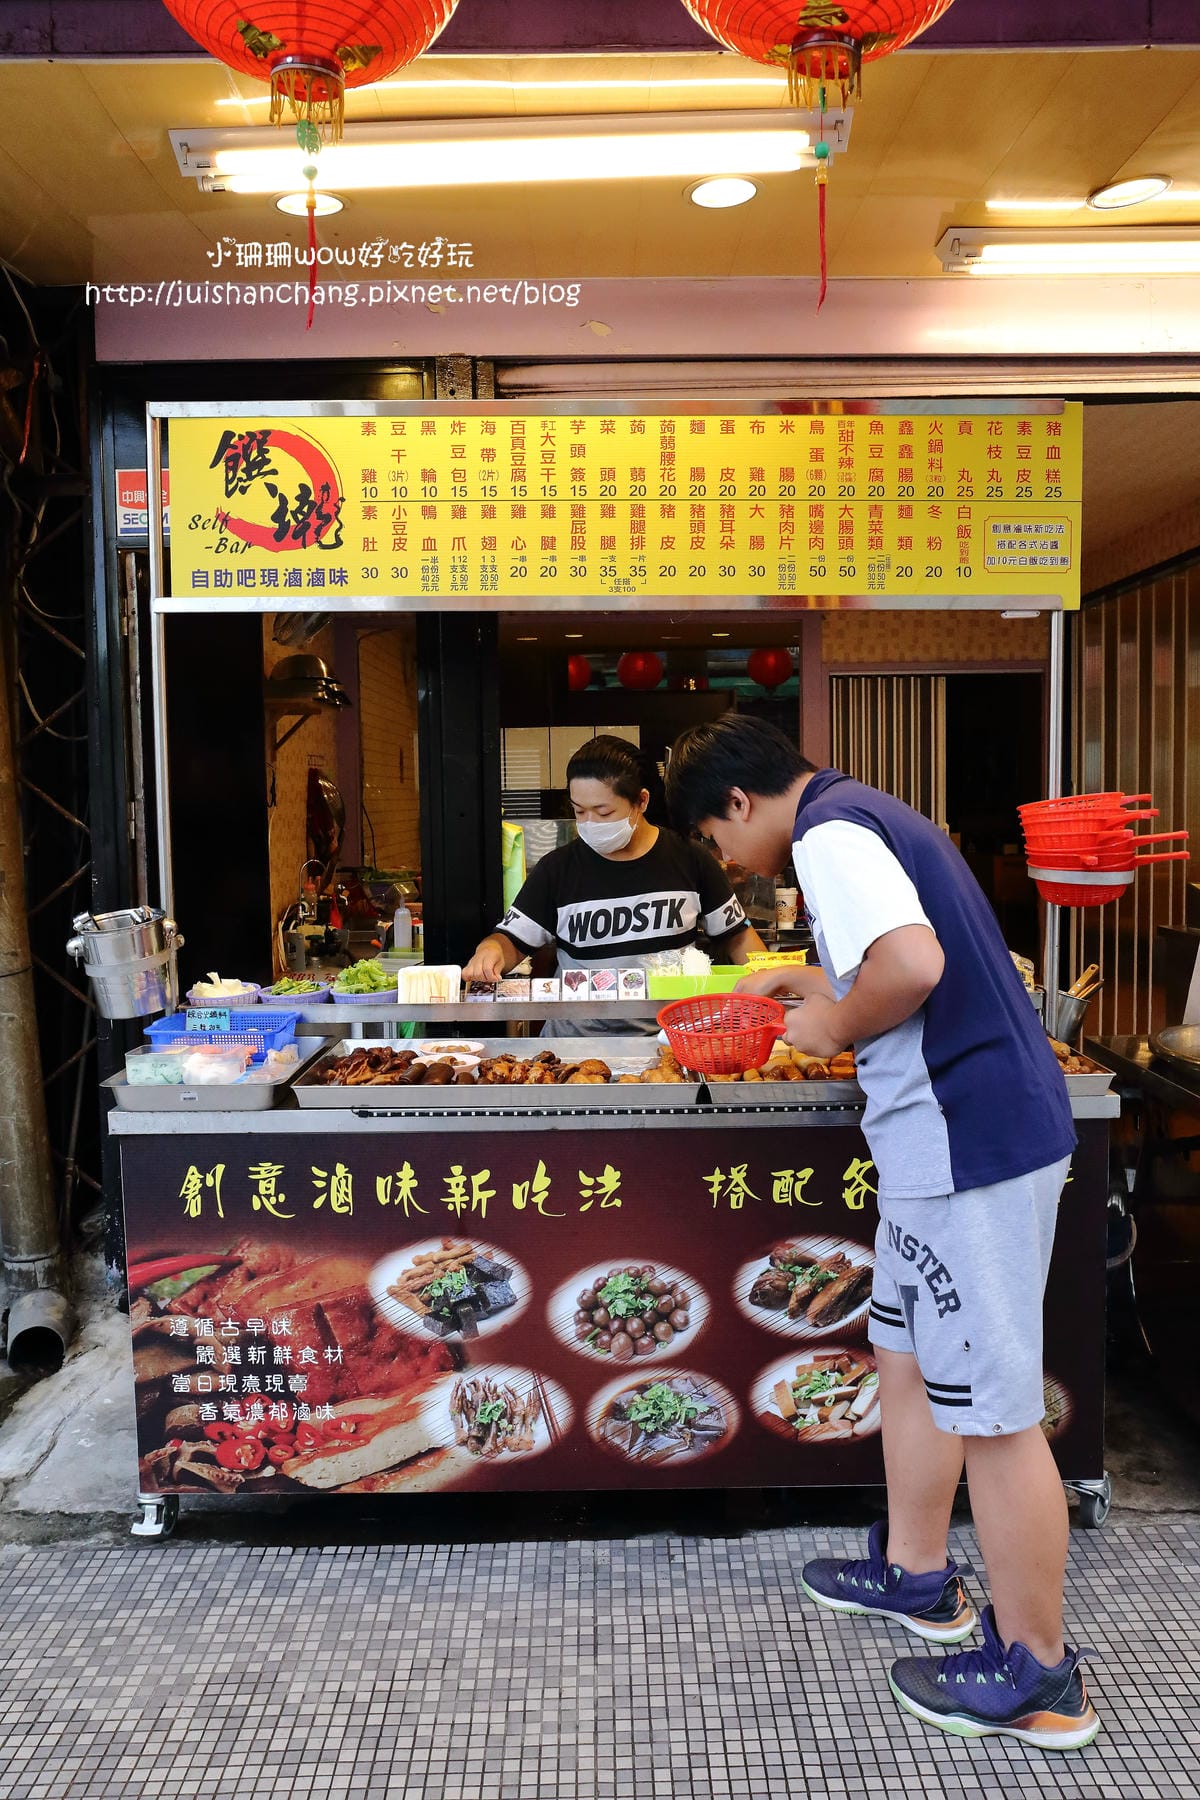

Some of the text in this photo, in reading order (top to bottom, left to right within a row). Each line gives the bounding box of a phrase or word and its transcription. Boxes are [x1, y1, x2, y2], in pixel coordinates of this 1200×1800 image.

[361, 421, 378, 498] 素雞 10
[391, 422, 407, 464] 豆干
[421, 421, 437, 497] 黑輪 10
[450, 420, 467, 497] 炸豆包 15
[480, 420, 496, 463] 海帶
[600, 420, 617, 496] 菜頭 20
[629, 420, 646, 496] 蒟蒻 20
[659, 419, 676, 496] 蒟蒻腰花 20
[719, 420, 736, 496] 蛋皮 20
[868, 420, 885, 497] 魚豆腐 20
[898, 420, 914, 497] 鑫鑫腸 20
[957, 421, 973, 497] 貢丸 25
[986, 421, 1003, 497] 花枝丸 25
[1016, 421, 1032, 498] 素豆皮 25
[1045, 421, 1062, 498] 豬血糕 25
[392, 486, 408, 498] 10
[481, 486, 497, 497] 15
[511, 485, 527, 497] 15
[540, 485, 557, 497] 15
[570, 485, 587, 496] 15
[689, 485, 706, 496] 20
[749, 485, 766, 496] 20
[778, 485, 795, 496] 20
[808, 485, 825, 496] 20
[838, 485, 855, 496] 20
[927, 486, 944, 497] 20
[188, 511, 230, 534] Self
[361, 505, 378, 579] 素肚 30
[391, 505, 408, 578] 小豆皮 30
[421, 505, 437, 551] 鴨血
[451, 505, 467, 551] 雞爪
[481, 504, 496, 551] 雞翅
[511, 504, 526, 551] 雞心
[541, 504, 556, 550] 雞腱
[570, 504, 586, 550] 雞屁股
[600, 504, 616, 550] 雞腿
[630, 504, 646, 550] 雞腿排
[659, 504, 676, 577] 豬皮 20
[689, 504, 706, 577] 豬頭皮 20
[719, 504, 736, 577] 豬耳朵 30
[748, 504, 765, 577] 大腸 30
[779, 504, 795, 550] 豬肉片
[809, 504, 824, 550] 嘴邊肉
[838, 504, 854, 550] 大腸頭
[868, 504, 883, 550] 青菜類
[925, 505, 942, 577] 冬粉 20
[957, 505, 971, 539] 白飯
[191, 567, 349, 589] 自助吧現滷滷味
[510, 566, 527, 577] 20
[540, 566, 557, 577] 20
[570, 566, 587, 577] 30
[600, 566, 617, 577] 35
[630, 566, 646, 577] 35
[809, 566, 826, 577] 50
[839, 566, 856, 577] 50
[896, 566, 913, 577] 20
[956, 566, 971, 577] 10
[569, 898, 687, 943] WODSTK
[180, 1159, 624, 1219] 創意滷味新吃法
[169, 1318, 293, 1337] 遵循古早味
[196, 1346, 344, 1366] 嚴選新鮮食材
[172, 1374, 308, 1393] 當日現煮現賣
[199, 1402, 336, 1422] 香氣濃郁滷味
